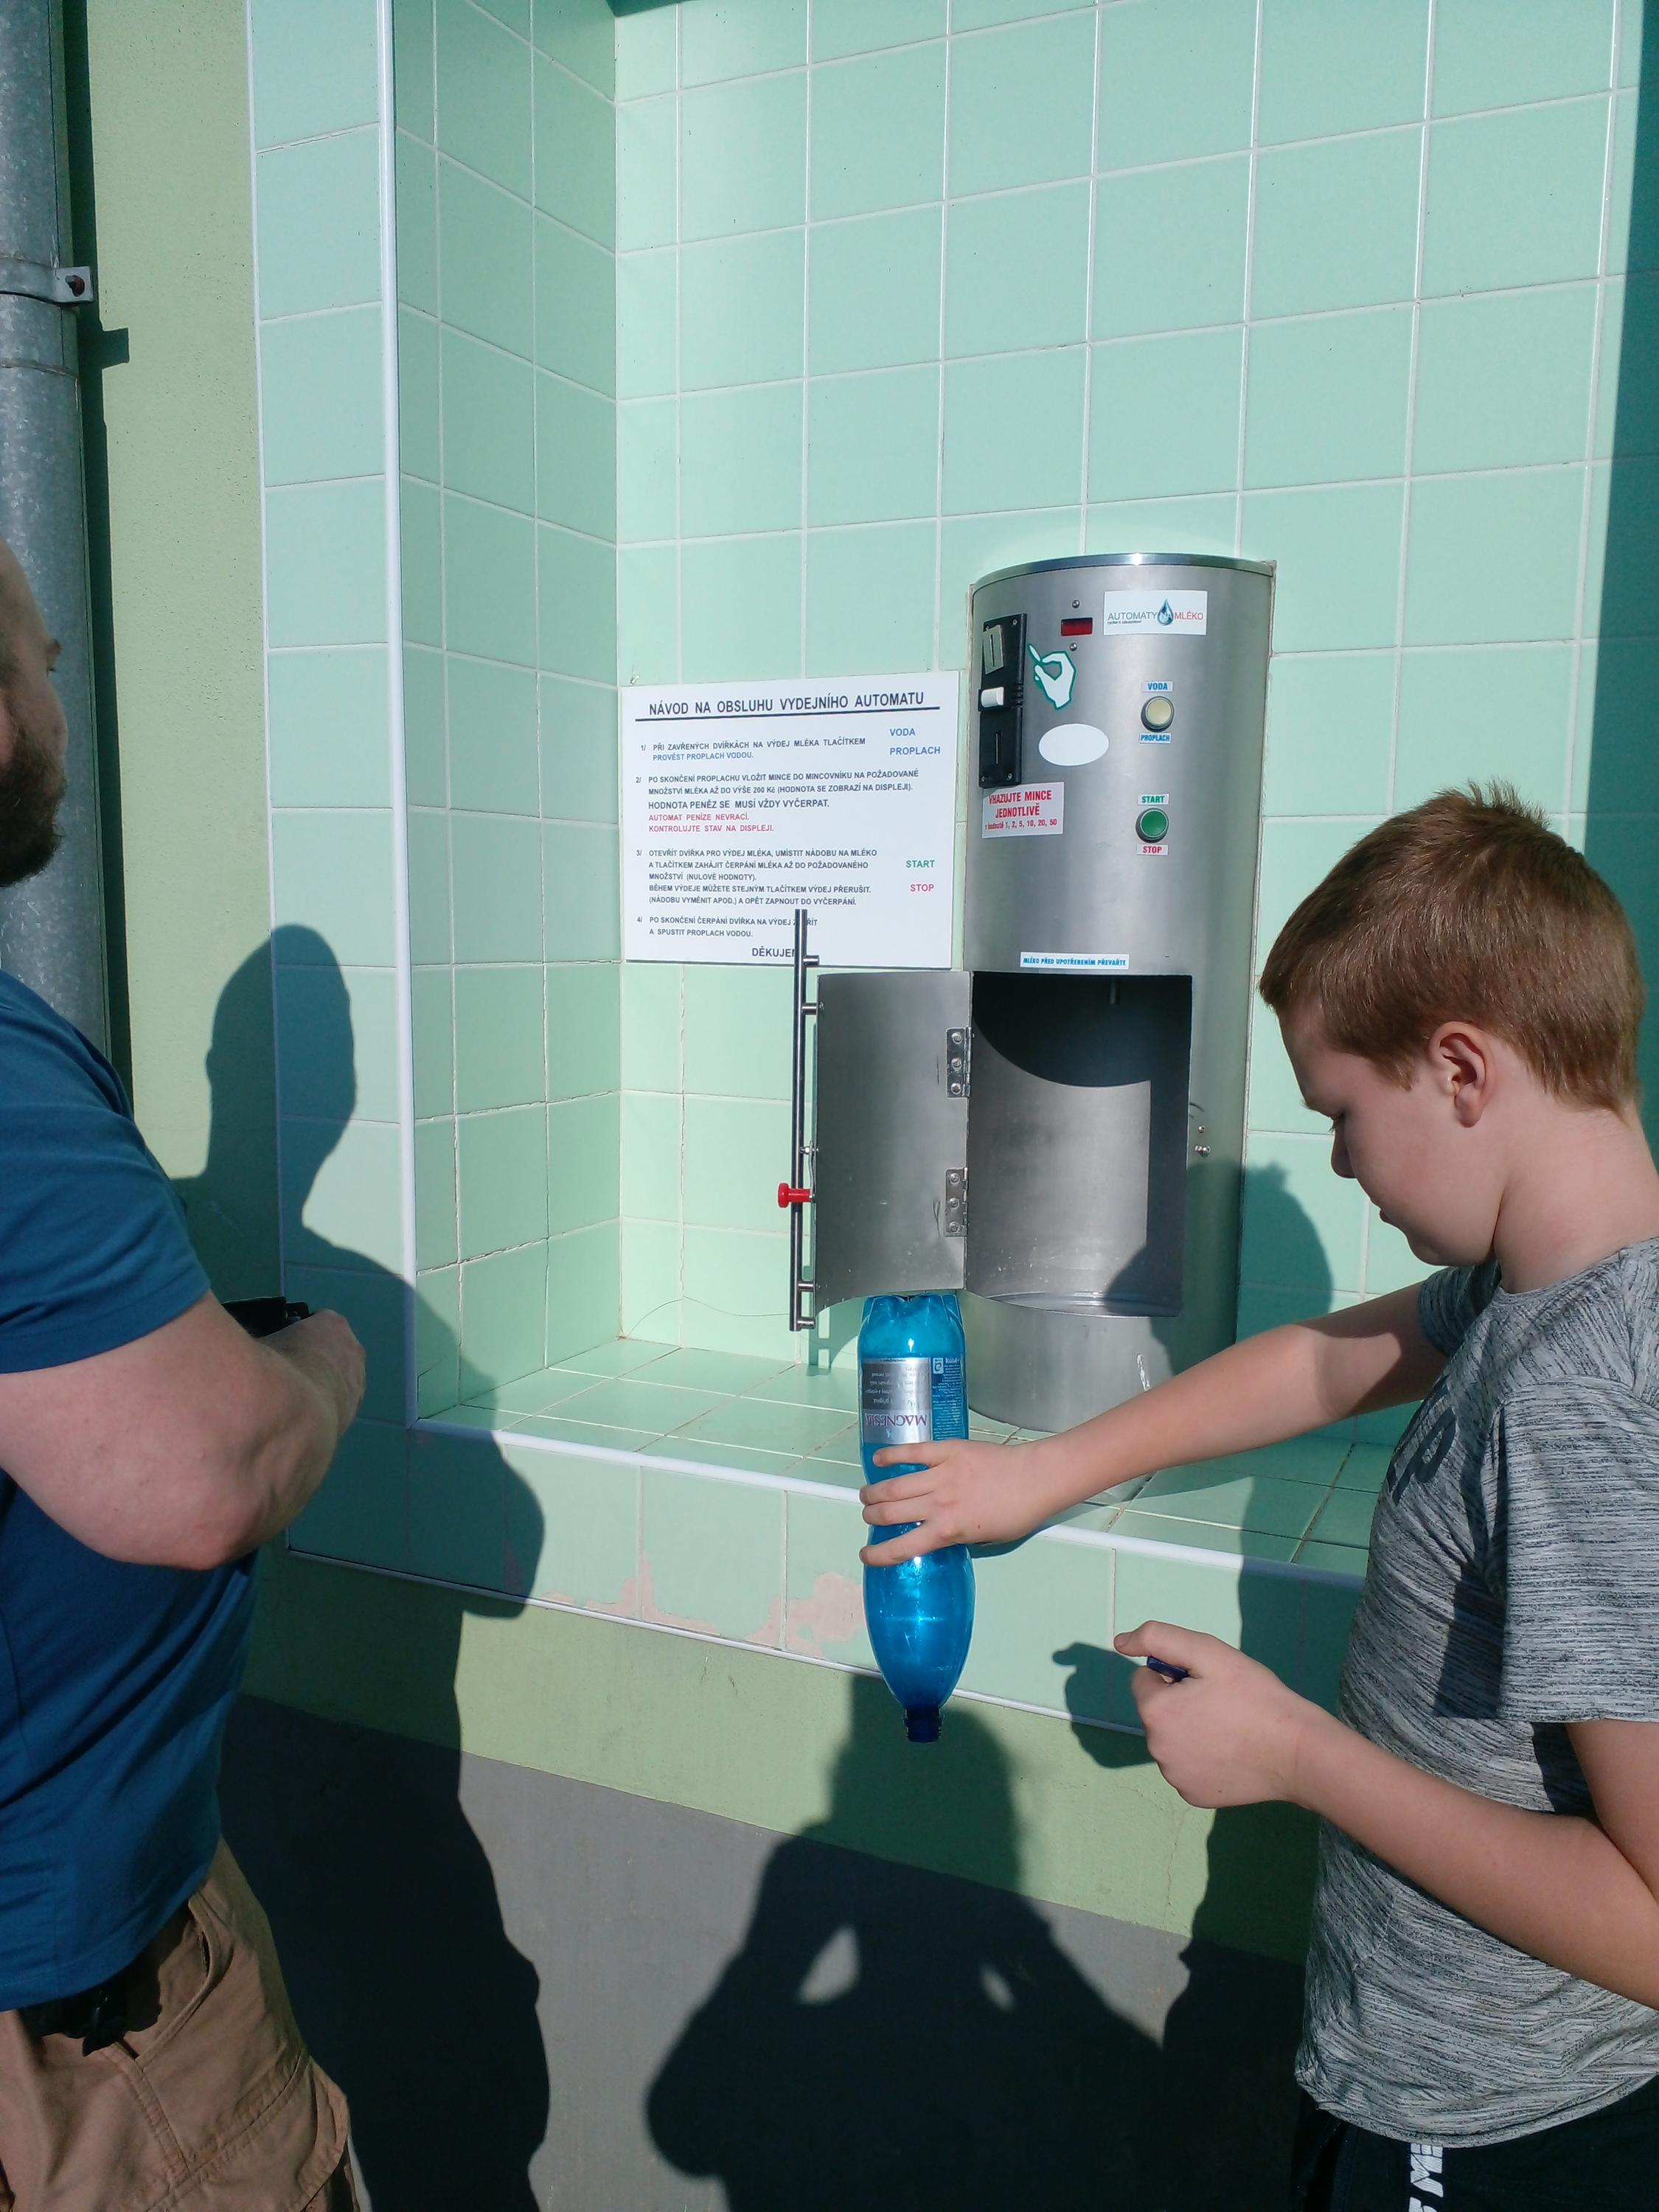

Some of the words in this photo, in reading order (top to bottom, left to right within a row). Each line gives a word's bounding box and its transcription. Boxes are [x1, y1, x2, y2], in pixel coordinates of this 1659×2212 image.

[1107, 611, 1158, 621] AUTOMATY
[1174, 611, 1203, 620] MLÉKO
[649, 700, 689, 715] NÁVOD
[695, 701, 711, 714] NA
[717, 699, 773, 713] OBSLUHU
[780, 693, 848, 710] VYDEJNÍHO
[855, 692, 923, 708] AUTOMATU
[889, 728, 916, 737] VODA
[653, 742, 664, 751] PŘI
[668, 742, 709, 751] ZAVŘENÝCH
[713, 740, 749, 749] DVÍŘKÁCH
[767, 739, 790, 748] VÝDEJ
[793, 737, 819, 747] MLÉKA
[824, 737, 866, 746] TLAČÍTKEM
[890, 746, 941, 756] PROPLACH
[653, 753, 685, 761] PROVÉST
[686, 752, 725, 761] PROPLACH
[660, 774, 695, 783] SKONČENÍ
[697, 774, 740, 782] PROPLACHU
[742, 773, 766, 782] VLOŽIT
[805, 771, 852, 780] MINCOVNÍKU
[866, 768, 919, 779] POŽADOVANÉ
[649, 786, 683, 795] MNOŽSTVÍ
[684, 786, 708, 794] MLÉKA
[709, 786, 719, 794] AŽ
[733, 785, 751, 793] VÝŠE
[777, 785, 815, 794] (HODNOTA
[828, 782, 861, 792] ZOBRAZÍ
[875, 783, 913, 792] DISPLEJI).
[989, 792, 1021, 804] VHAZUJTE
[1024, 790, 1051, 801] MINCE
[649, 801, 688, 810] HODNOTA
[690, 799, 717, 809] PENĚZ
[734, 798, 756, 808] MUSÍ
[758, 798, 781, 808] VŽDY
[782, 797, 830, 808] VYČERPAT.
[995, 802, 1040, 818] JEDNOTLIVĚ
[686, 813, 712, 821] PENÍZE
[715, 812, 749, 821] NEVRACÍ.
[1012, 821, 1017, 829] 2,
[1019, 820, 1025, 828] 5,
[649, 849, 678, 857] OTEVŘÍT
[679, 849, 705, 857] DVÍŘKA
[723, 848, 745, 857] VÝDEJ
[747, 848, 773, 858] MLÉKA,
[775, 848, 804, 857] UMÍSTIT
[805, 847, 836, 857] NÁDOBU
[851, 848, 877, 857] MLÉKO
[1143, 846, 1162, 854] STOP
[655, 860, 693, 869] TLAČÍTKEM
[695, 860, 723, 869] ZAHÁJIT
[725, 860, 756, 869] ČERPÁNÍ
[758, 860, 782, 869] MLÉKA
[784, 860, 793, 869] AŽ
[807, 860, 869, 869] POŽADOVANÉHO
[905, 860, 935, 868] START
[649, 872, 684, 880] MNOŽSTVÍ
[686, 872, 717, 881] (NULOVÉ
[718, 874, 757, 882] HODNOTY).
[649, 883, 672, 891] BĚHEM
[674, 883, 700, 892] VÝDEJE
[702, 883, 731, 892] MŮŽETE
[732, 884, 765, 892] STEJNÝM
[766, 884, 807, 893] TLAČÍTKEM
[808, 885, 832, 894] VÝDEJ
[833, 884, 872, 894] PŘERUŠIT.
[910, 884, 934, 892] STOP
[649, 894, 681, 904] (NÁDOBU
[681, 895, 712, 904] VYMĚNIT
[745, 896, 763, 904] OPĚT
[765, 897, 799, 905] ZAPNOUT
[813, 897, 856, 905] VYČERPÁNÍ.
[661, 915, 696, 924] SKONČENÍ
[698, 916, 728, 925] ČERPÁNÍ
[729, 917, 755, 925] DVÍŘKA
[768, 917, 791, 926] VÝDEJ
[1023, 956, 1040, 964] MLÉKO
[1040, 956, 1054, 964] PŘED
[1056, 957, 1096, 966] UPOTŘEBENÍM
[1097, 958, 1126, 966] PŘEVAŘTE
[864, 1413, 928, 1427] MAGNESIA
